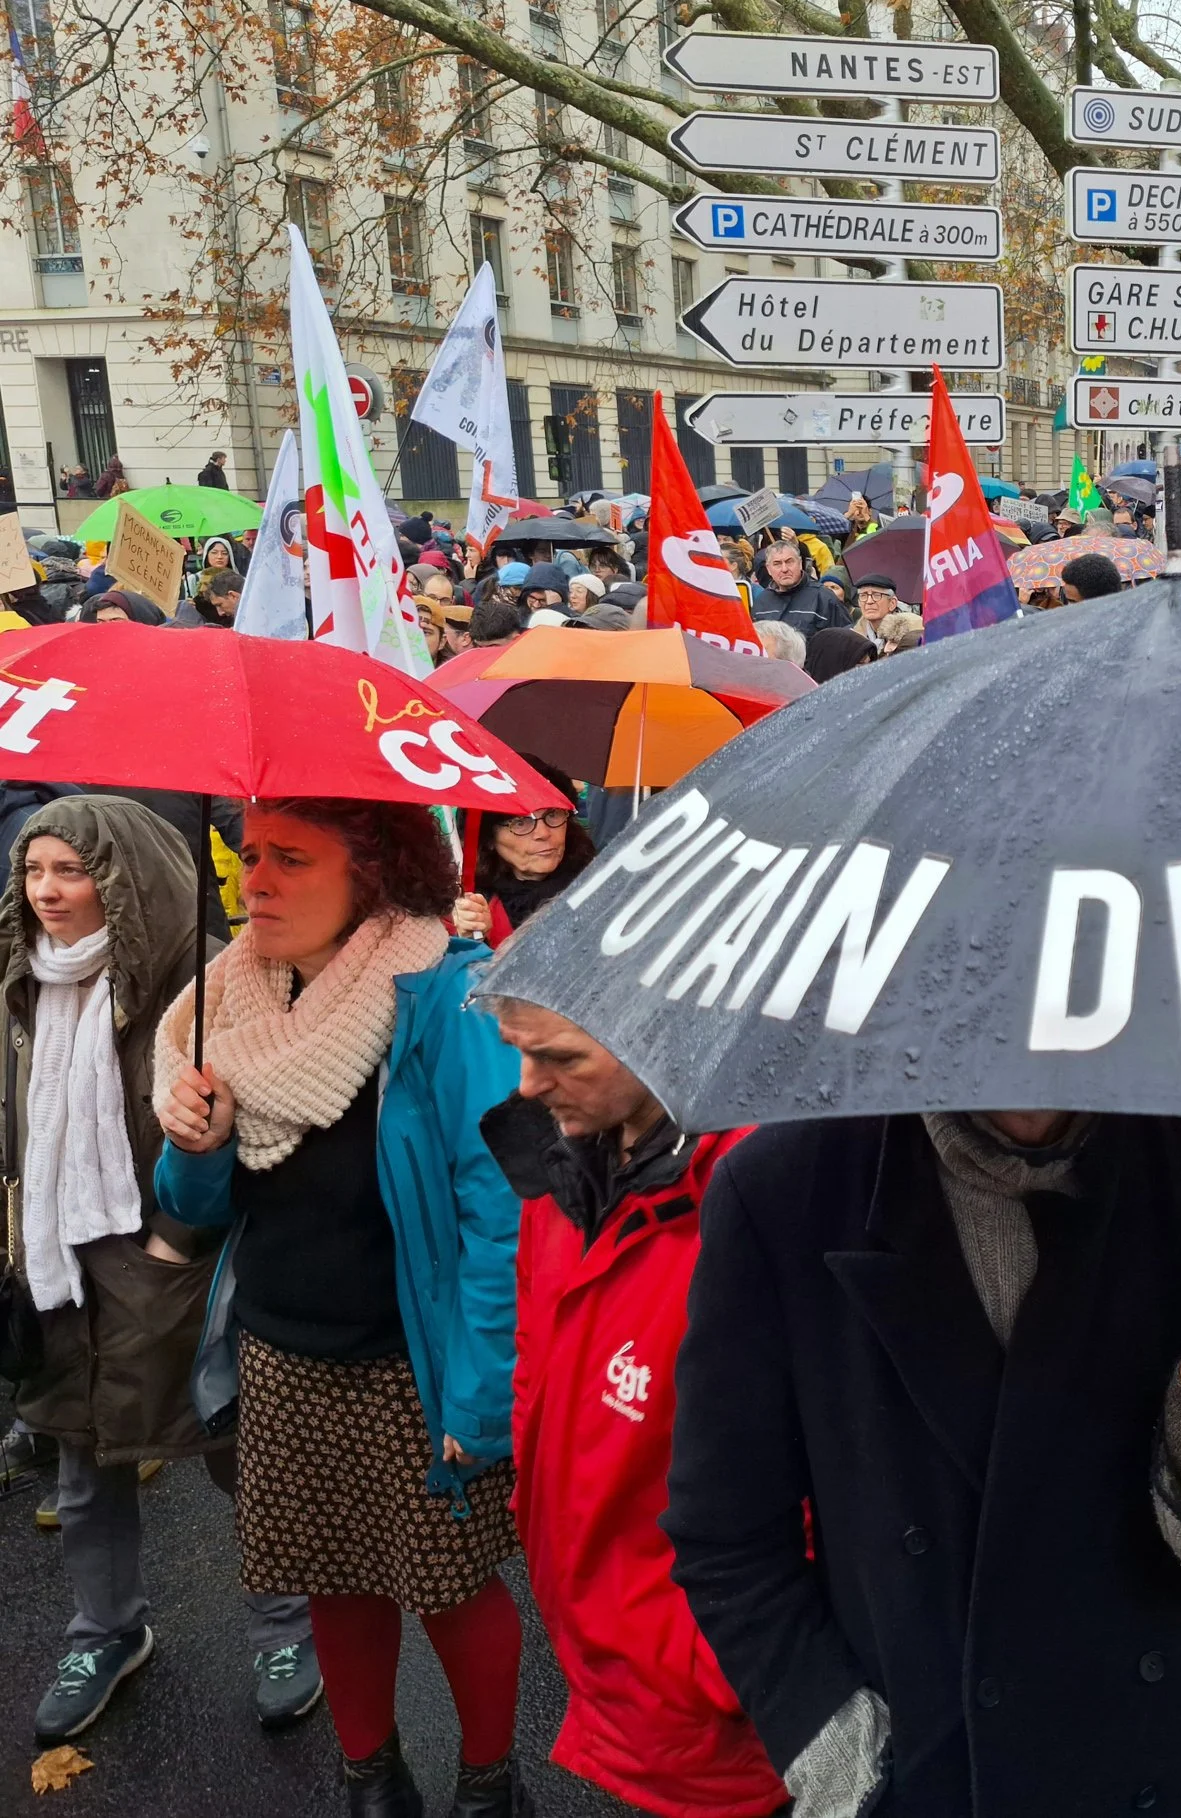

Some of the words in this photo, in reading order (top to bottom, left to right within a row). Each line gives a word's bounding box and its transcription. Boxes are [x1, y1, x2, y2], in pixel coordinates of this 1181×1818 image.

[846, 133, 988, 167] CLÉMENT
[1091, 192, 1112, 219] P
[1128, 212, 1138, 231] à
[716, 209, 739, 235] P
[752, 210, 914, 243] CATHÉDRALE
[919, 228, 929, 244] à
[934, 225, 988, 246] 300m
[738, 292, 819, 319] Hôtel
[1088, 281, 1160, 307] GARE
[741, 327, 774, 351] du
[798, 327, 990, 359] Département
[120, 533, 150, 562] MORT
[156, 561, 171, 579] EN
[567, 788, 952, 1035] PUTAIN
[606, 1356, 653, 1402] cgt
